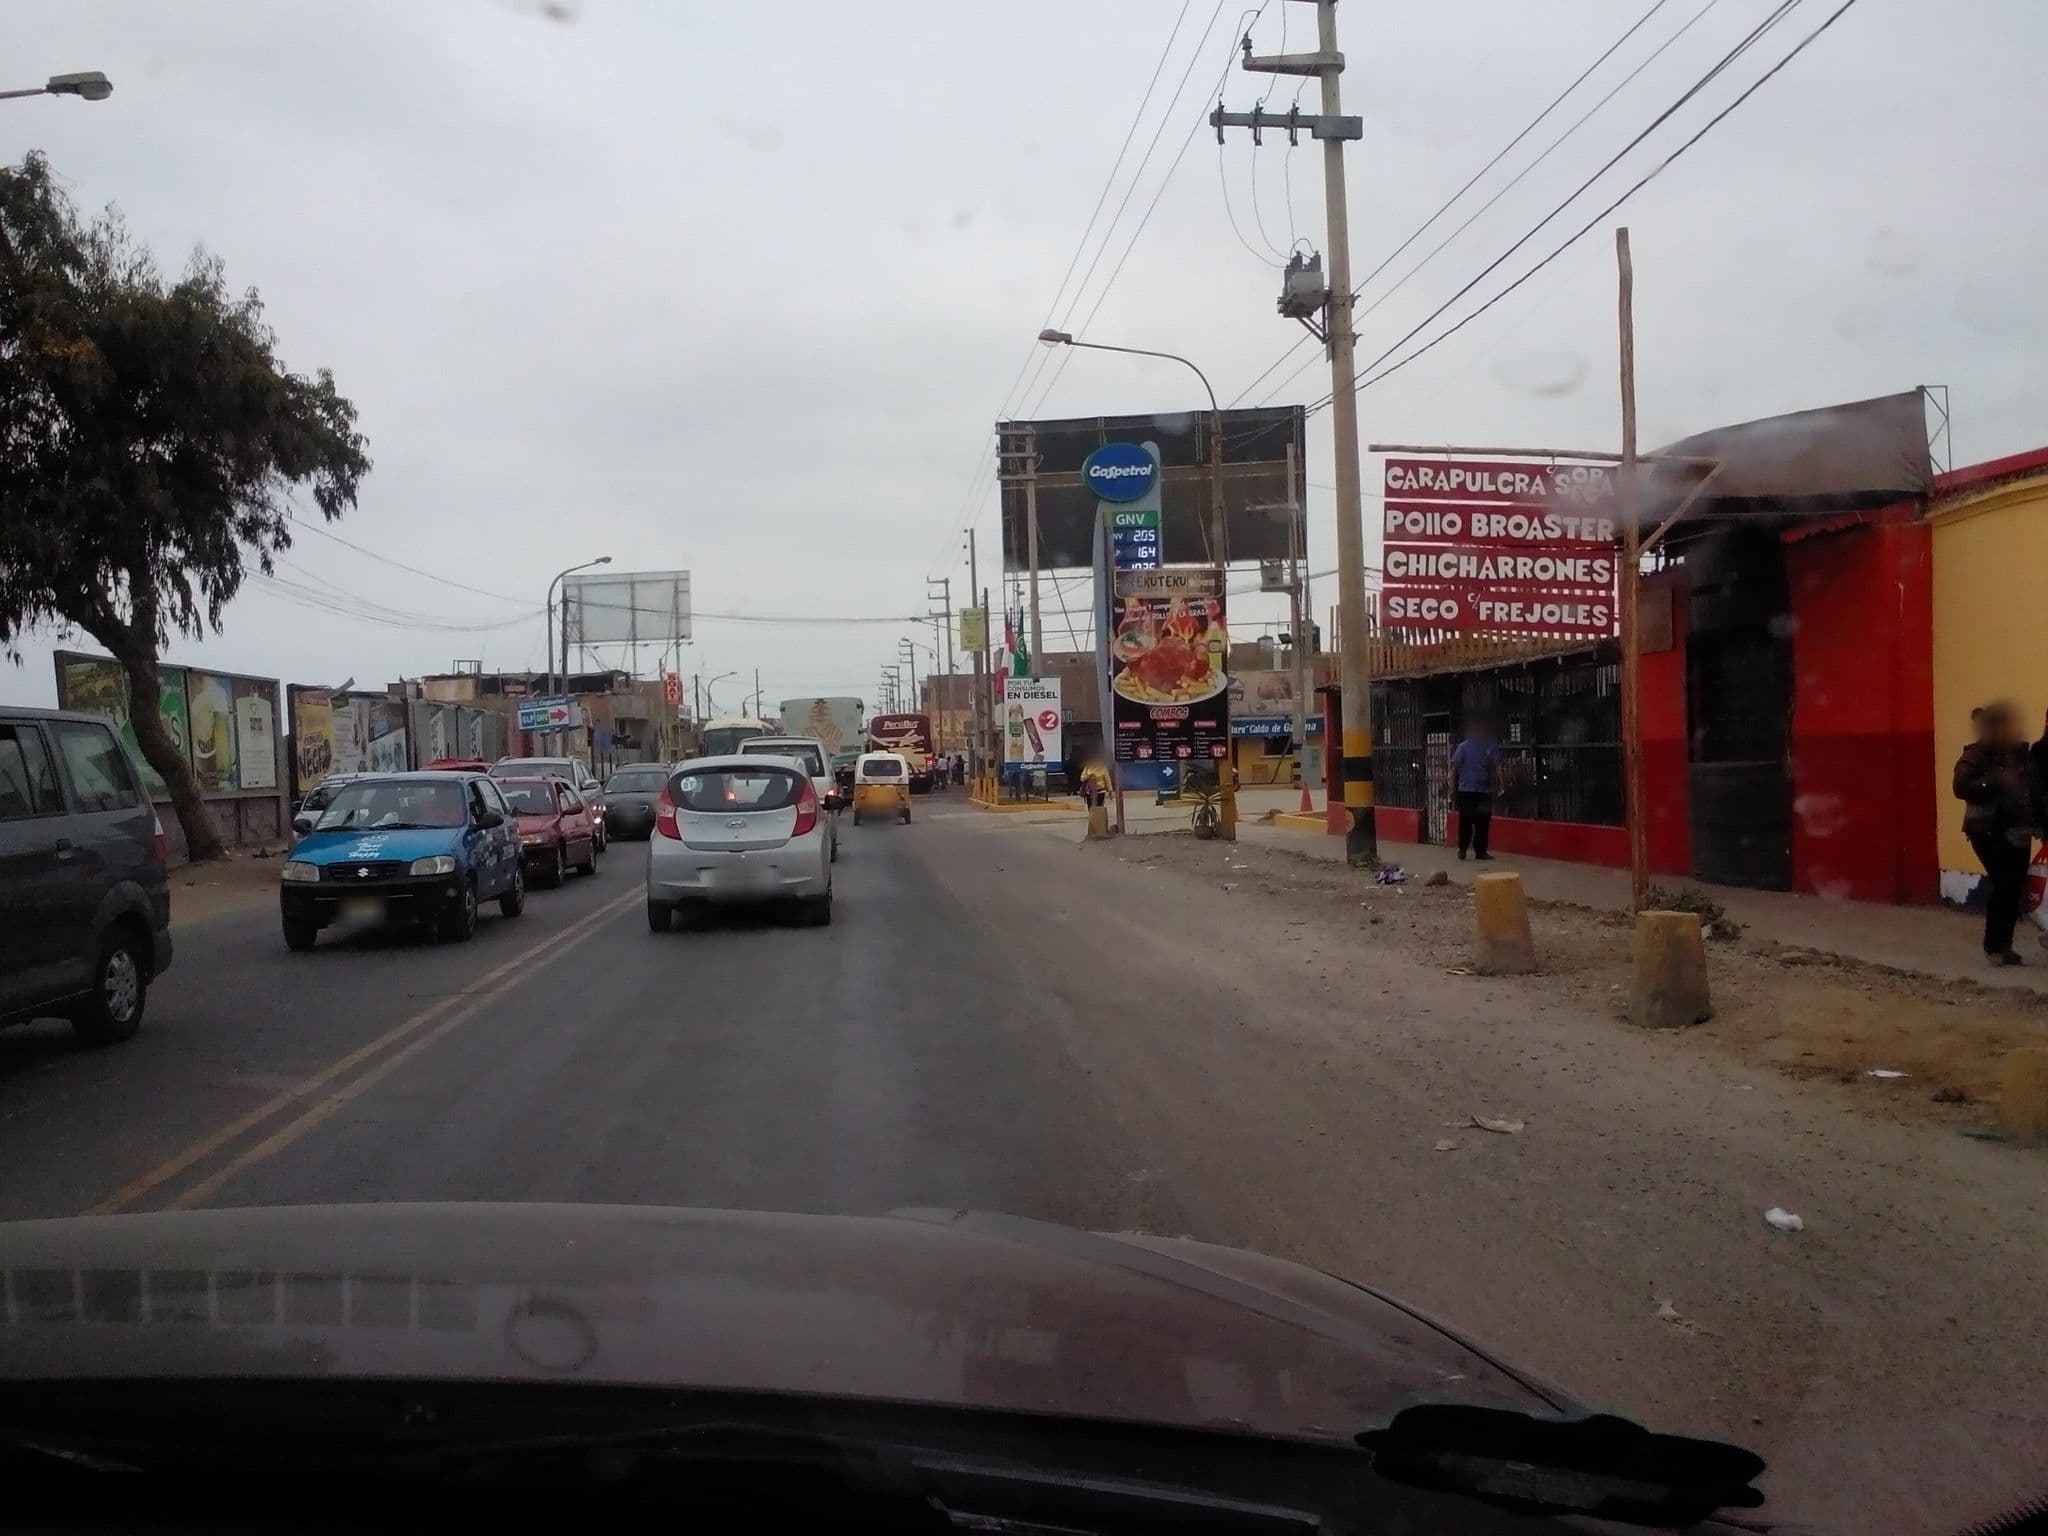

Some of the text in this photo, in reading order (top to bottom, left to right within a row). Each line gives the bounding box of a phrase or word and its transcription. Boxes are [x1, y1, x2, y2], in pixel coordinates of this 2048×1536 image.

[1387, 466, 1546, 495] CARAPULCRA
[1115, 514, 1145, 525] GNV
[1471, 513, 1614, 542] BROASTER
[1387, 551, 1610, 584] CHICHARRONES
[1389, 596, 1459, 620] SECO
[1479, 601, 1608, 627] FREJOLES
[1007, 691, 1059, 700] EN DIESEL
[1249, 724, 1270, 733] Caldo
[1271, 723, 1281, 733] de
